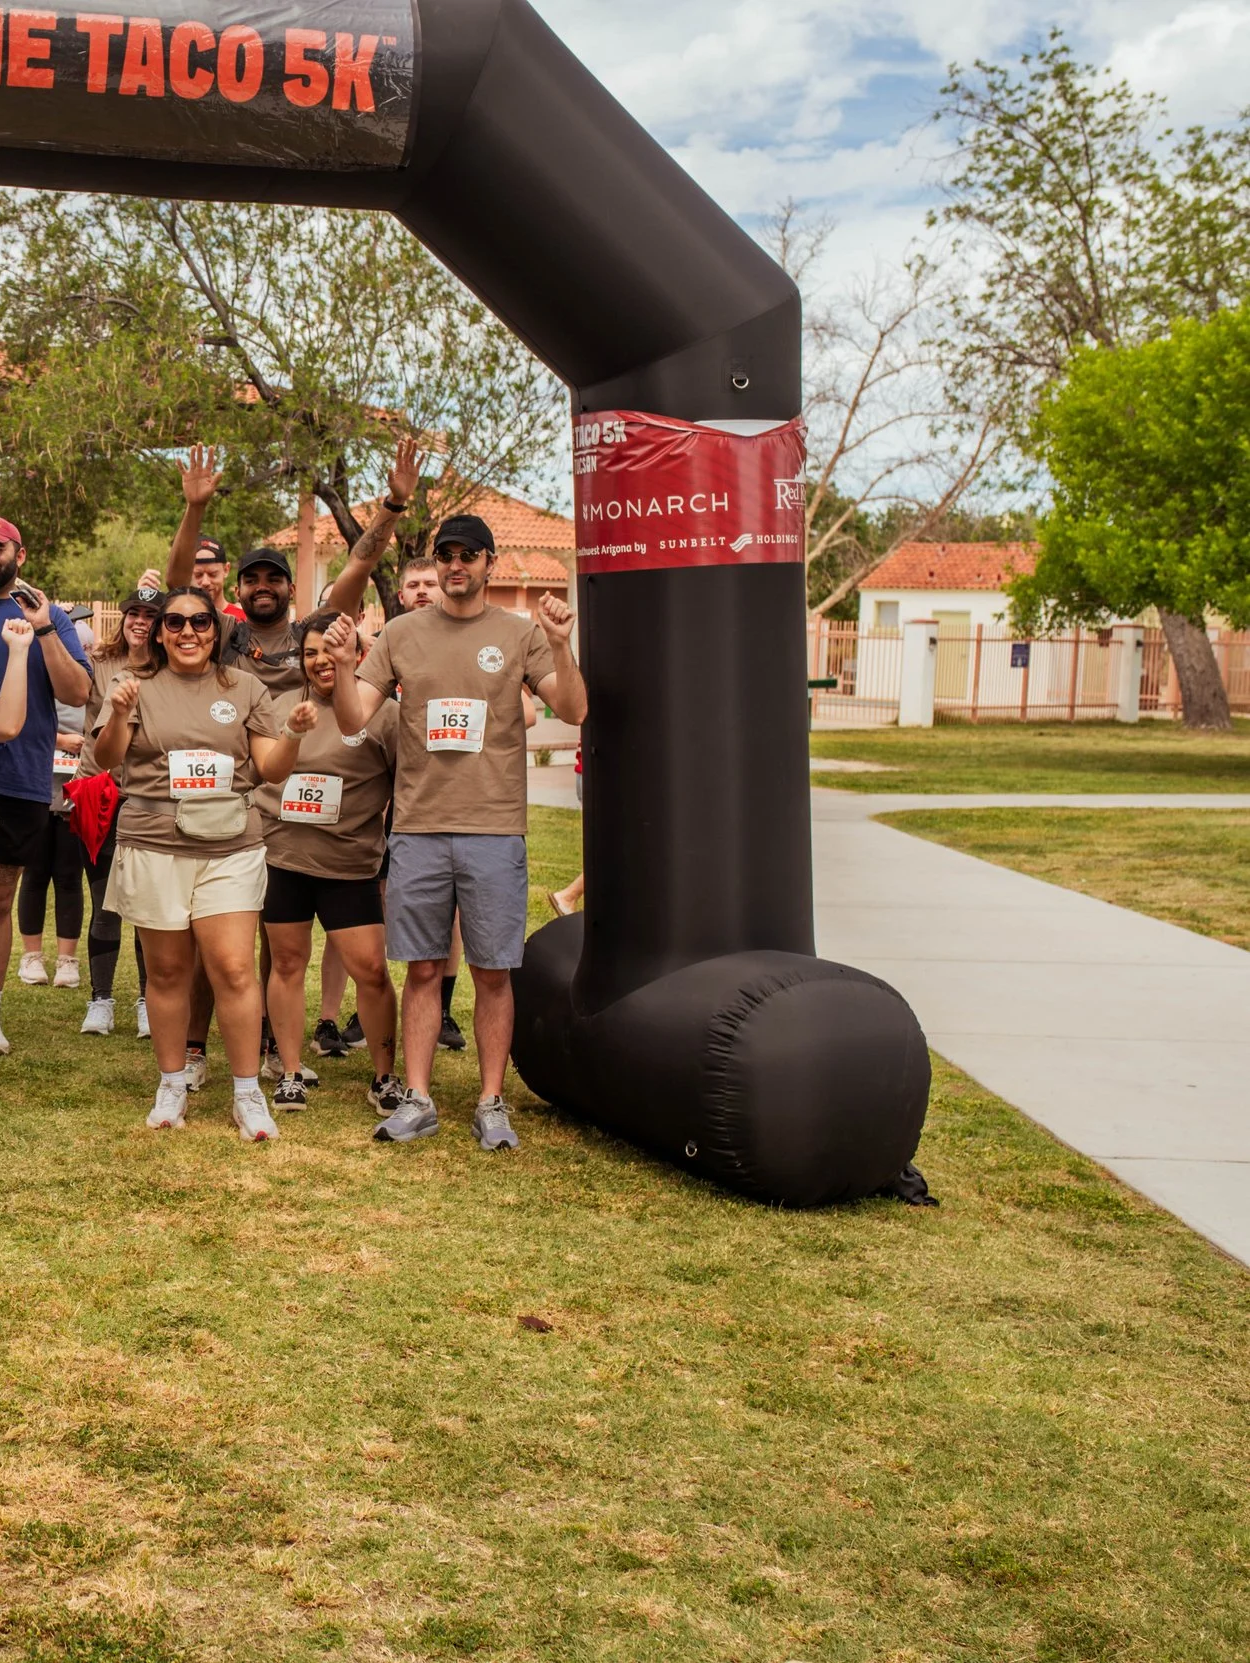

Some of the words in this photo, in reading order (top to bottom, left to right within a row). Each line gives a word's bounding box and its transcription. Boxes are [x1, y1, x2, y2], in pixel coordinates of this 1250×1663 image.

[76, 12, 264, 103] TACO
[574, 422, 600, 449] TACO
[602, 420, 627, 444] 5K
[773, 482, 799, 510] Red
[590, 492, 729, 521] MONARCH
[601, 544, 632, 556] Arizona
[634, 542, 647, 555] by
[659, 536, 726, 550] SUNBELT
[756, 534, 798, 544] HOLDINGS
[441, 713, 469, 728] 163
[187, 763, 217, 777] 164
[298, 788, 324, 802] 162
